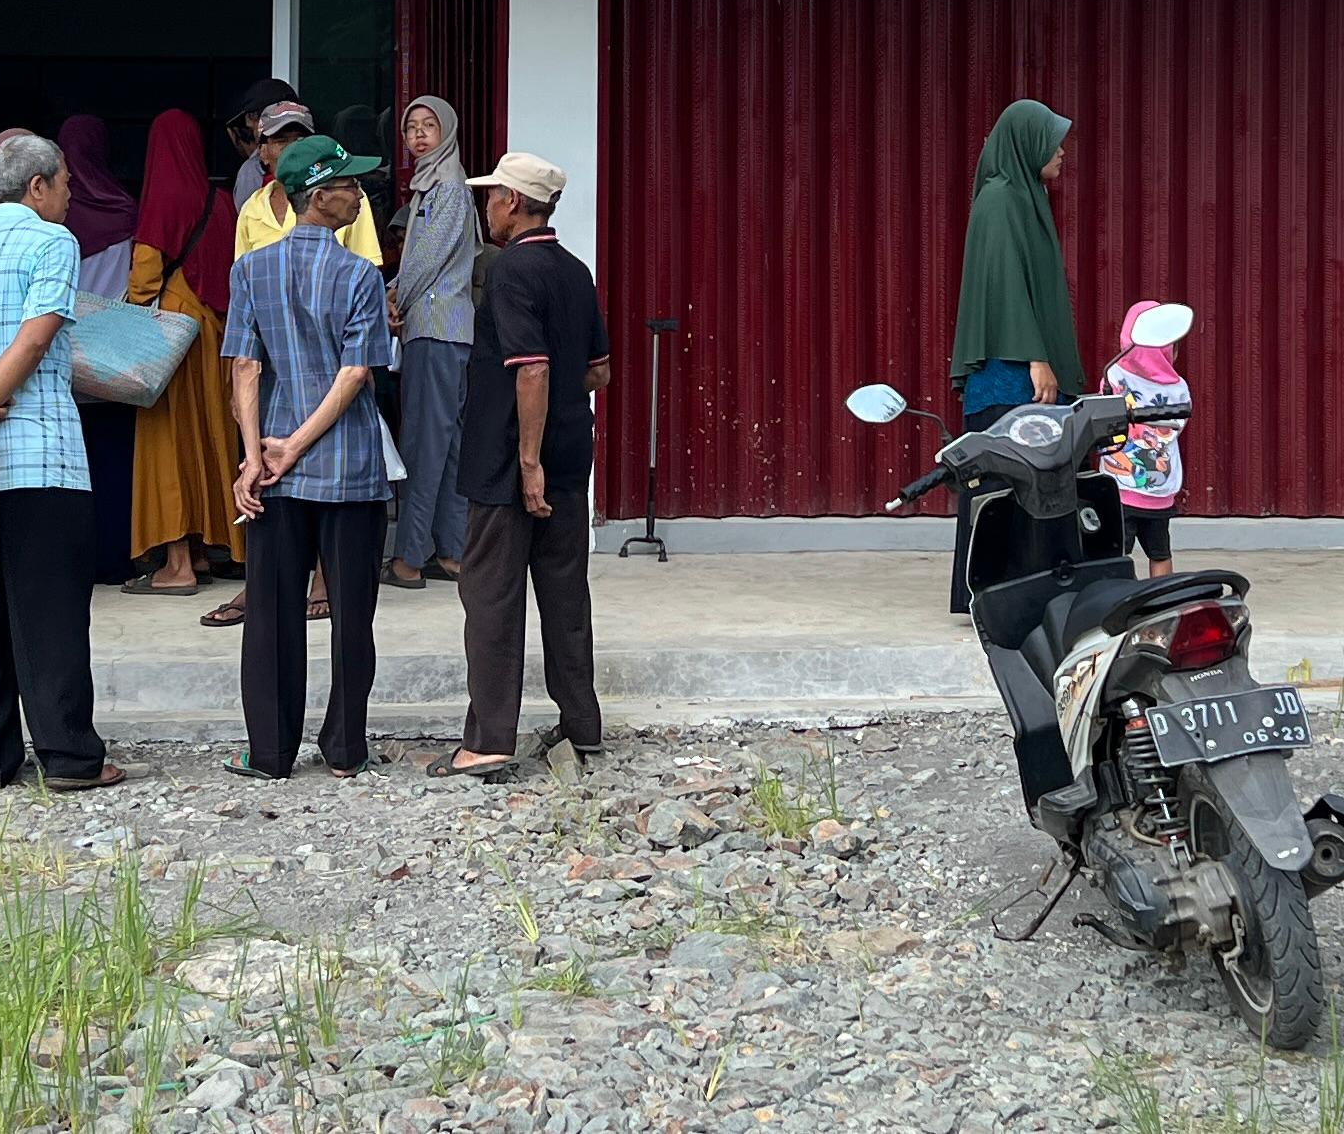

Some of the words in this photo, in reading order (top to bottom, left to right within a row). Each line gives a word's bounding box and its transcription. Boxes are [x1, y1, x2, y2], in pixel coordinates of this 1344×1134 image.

[1190, 668, 1224, 682] HONDA
[1153, 713, 1169, 736] D
[1181, 700, 1239, 732] 3711
[1274, 692, 1300, 715] JD
